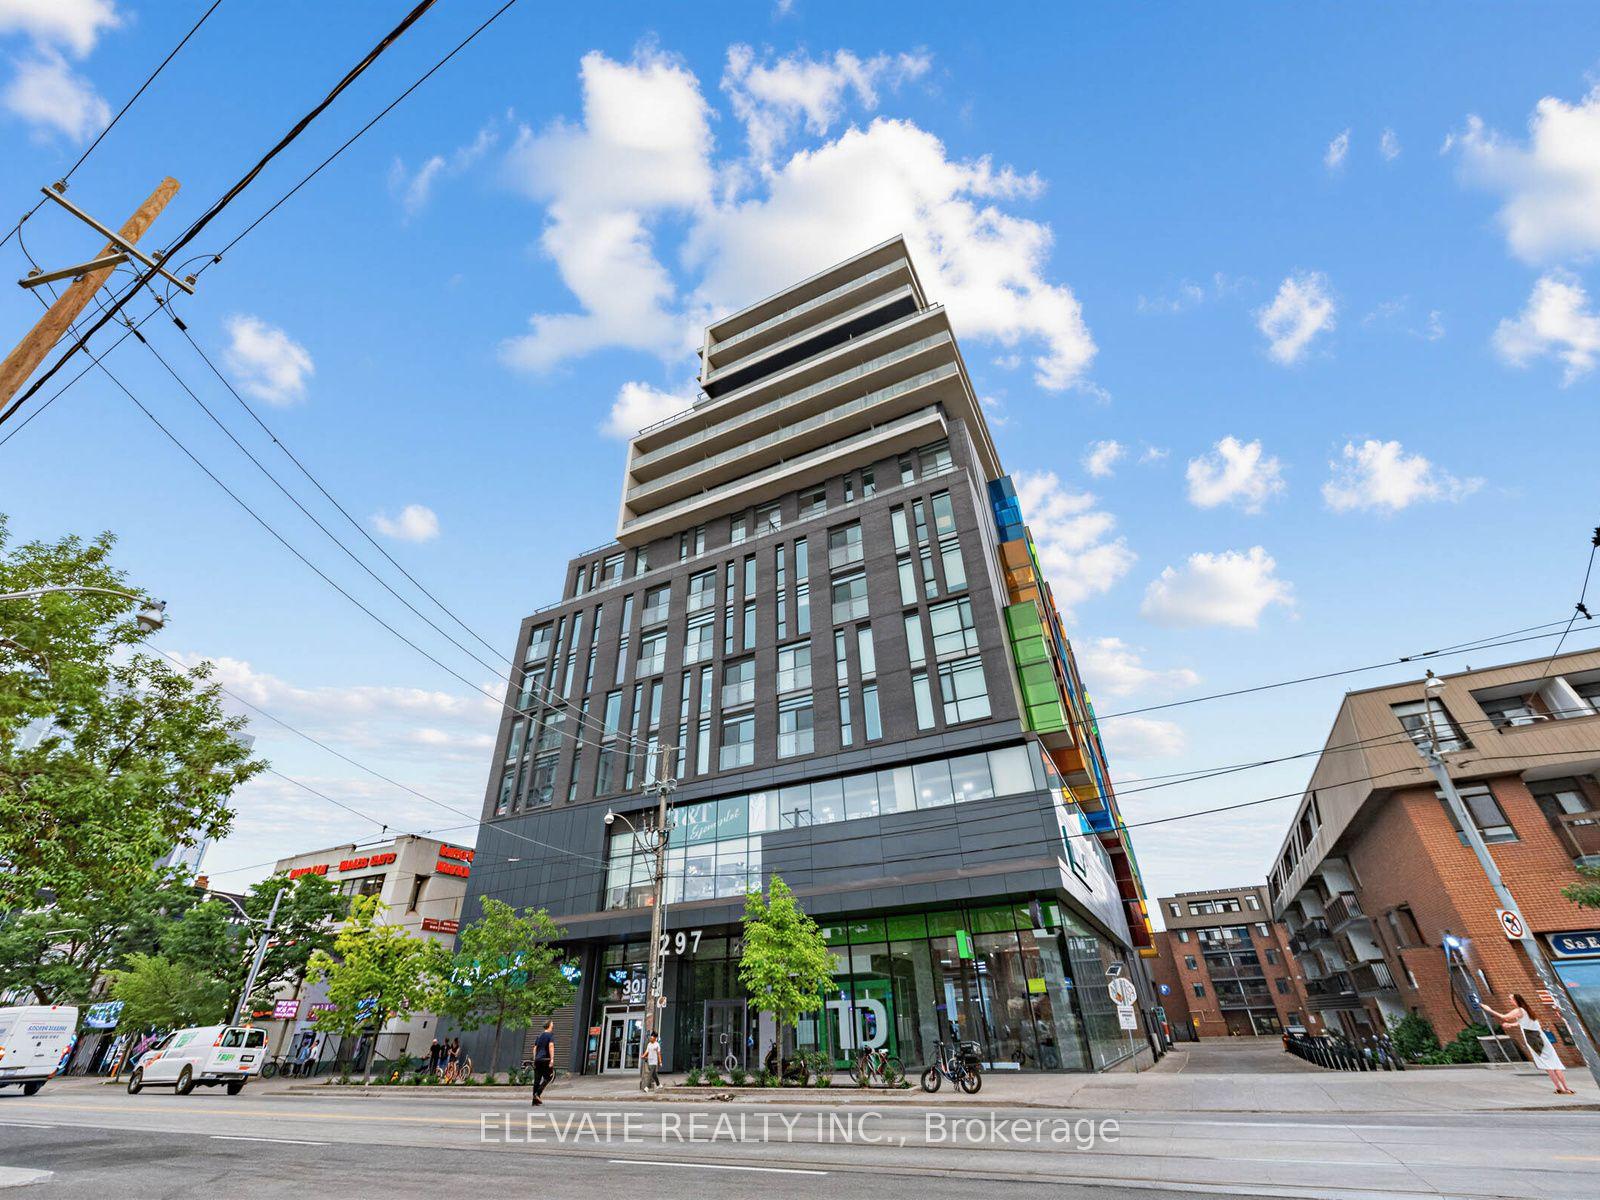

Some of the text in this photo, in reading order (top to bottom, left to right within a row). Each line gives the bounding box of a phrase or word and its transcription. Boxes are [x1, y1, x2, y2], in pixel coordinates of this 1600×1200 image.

[660, 930, 702, 955] 297
[622, 978, 647, 995] 301
[826, 998, 888, 1050] TD
